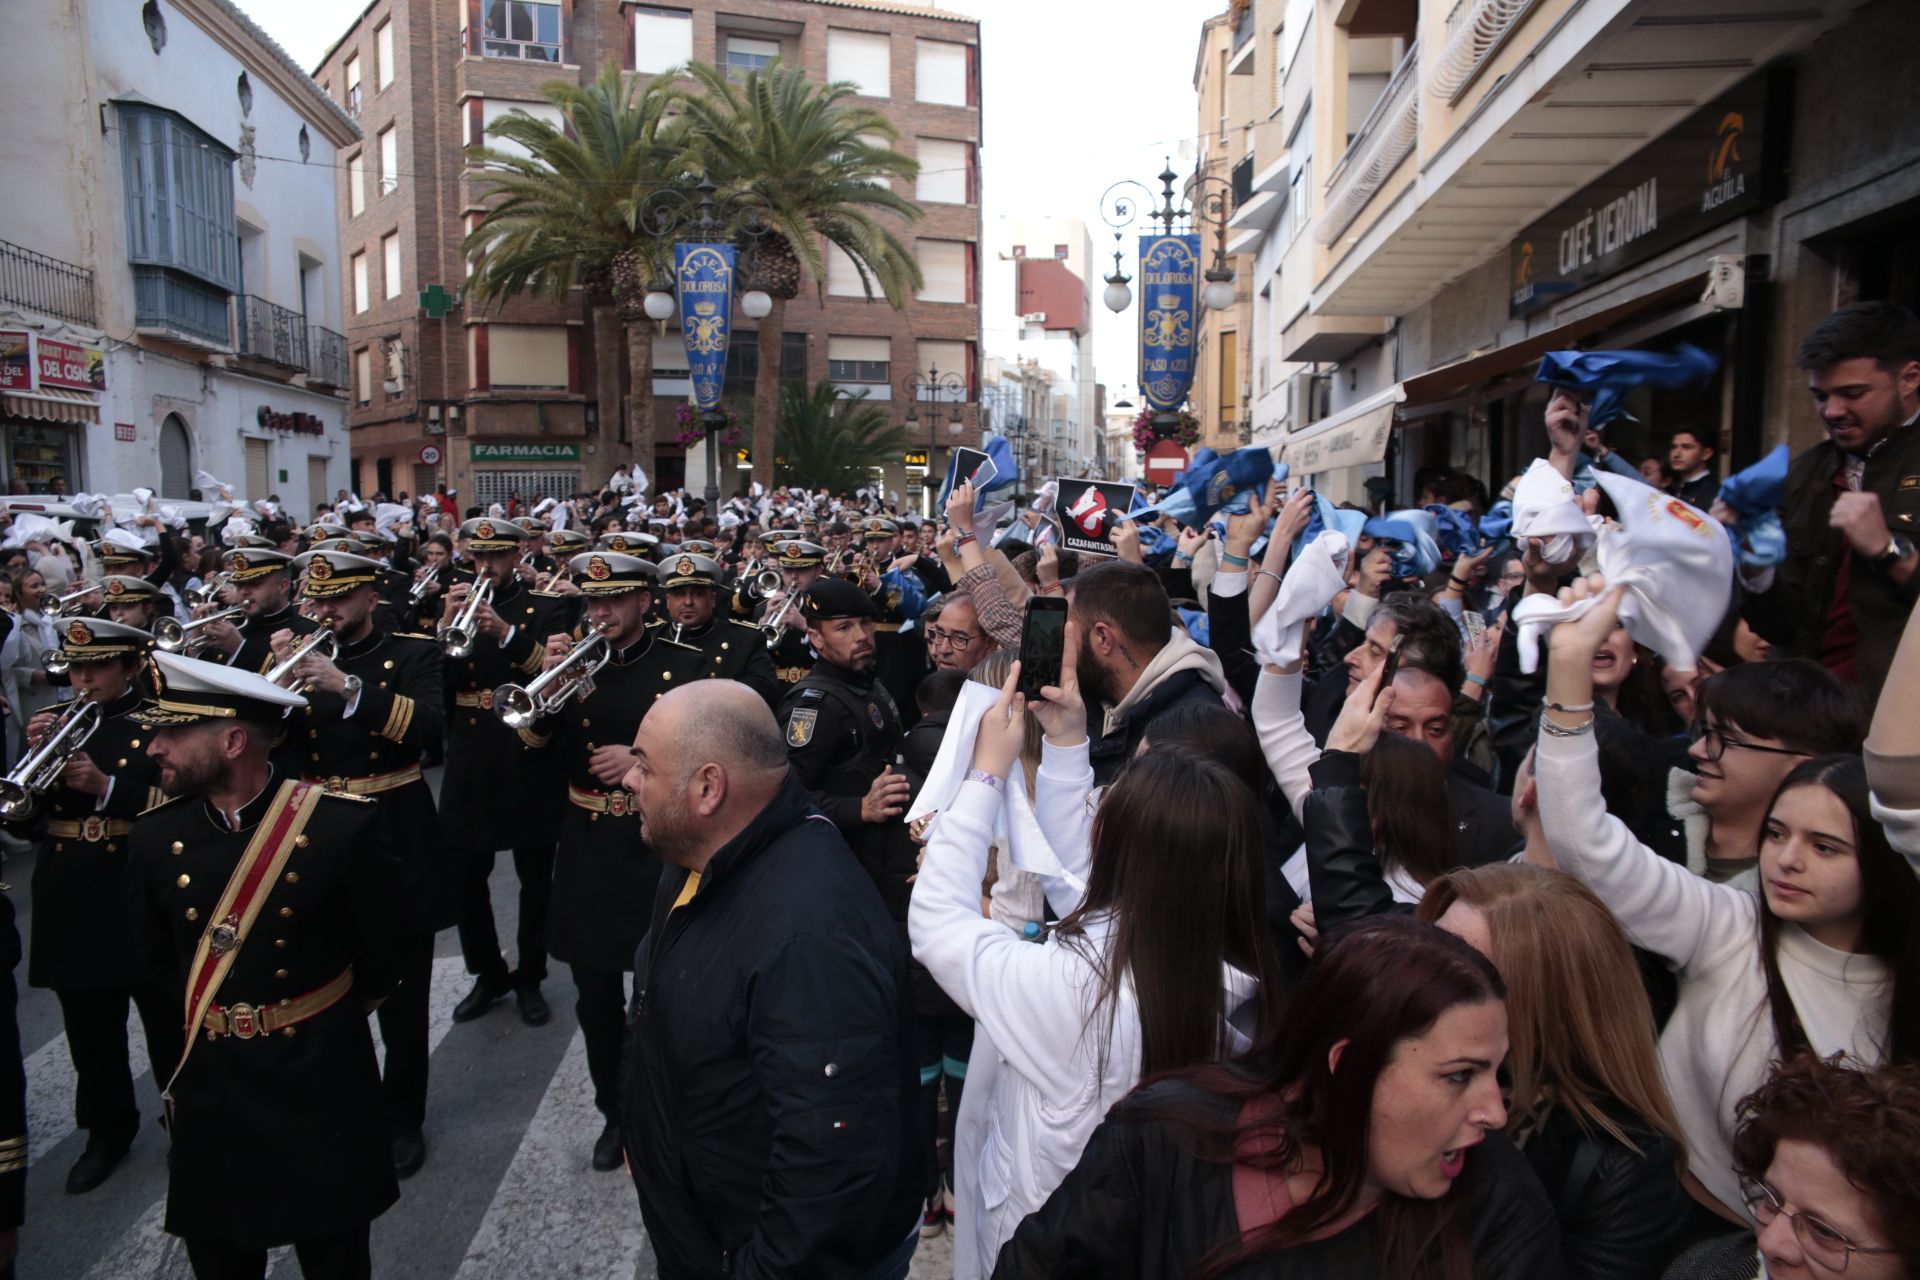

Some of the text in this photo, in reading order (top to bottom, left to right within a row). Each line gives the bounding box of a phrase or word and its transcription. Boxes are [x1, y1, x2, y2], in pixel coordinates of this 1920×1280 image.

[1702, 173, 1745, 212] AGUILA
[1559, 178, 1658, 276] CAFÉ VERONA
[1149, 246, 1190, 269] MATER
[685, 256, 724, 278] MATER
[1145, 272, 1193, 285] DOLOROSA
[682, 281, 727, 293] DOLOROSA
[4, 366, 24, 376] DEL
[43, 359, 92, 383] DEL CISNE
[1145, 359, 1167, 371] PASO
[424, 450, 437, 460] 20
[475, 445, 574, 456] FARMACIA
[1068, 537, 1118, 552] CAZAFANTASM
